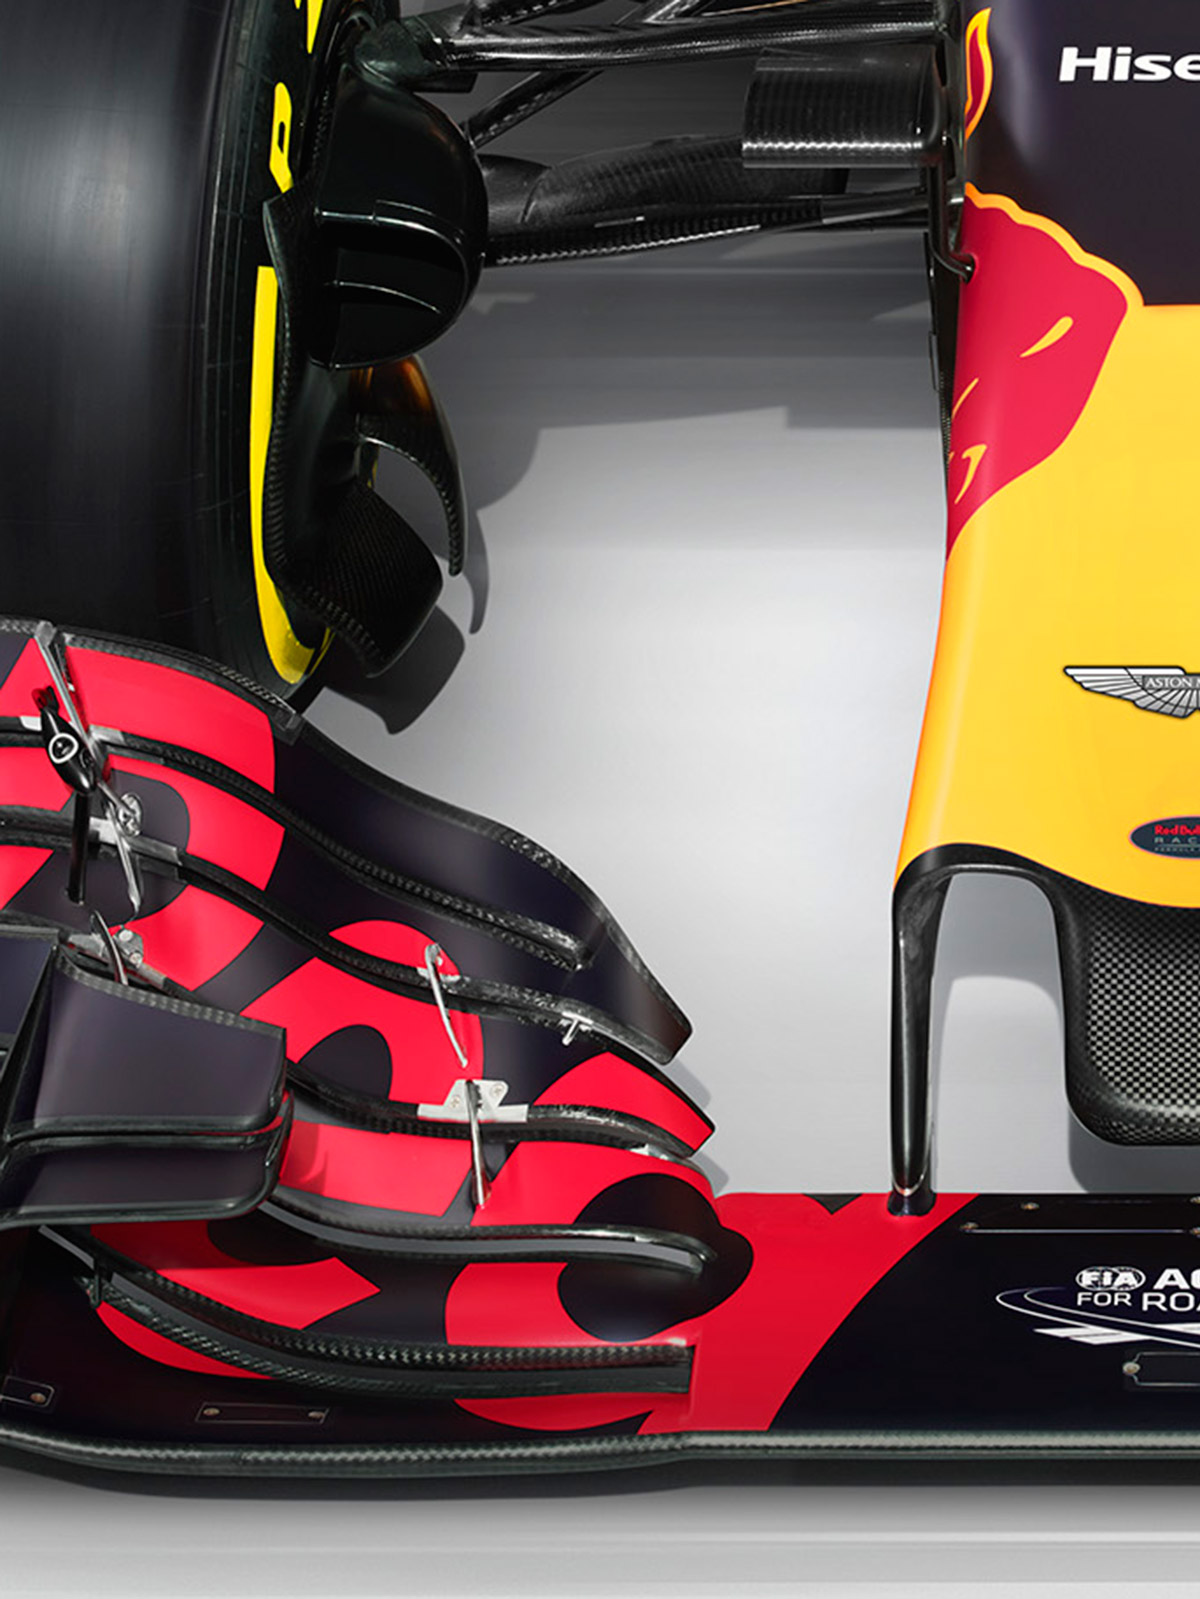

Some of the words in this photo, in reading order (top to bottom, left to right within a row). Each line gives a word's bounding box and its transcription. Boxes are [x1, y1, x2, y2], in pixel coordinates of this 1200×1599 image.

[1145, 676, 1191, 689] ASTON
[1080, 1270, 1140, 1287] FIA
[1077, 1292, 1132, 1306] FOR
